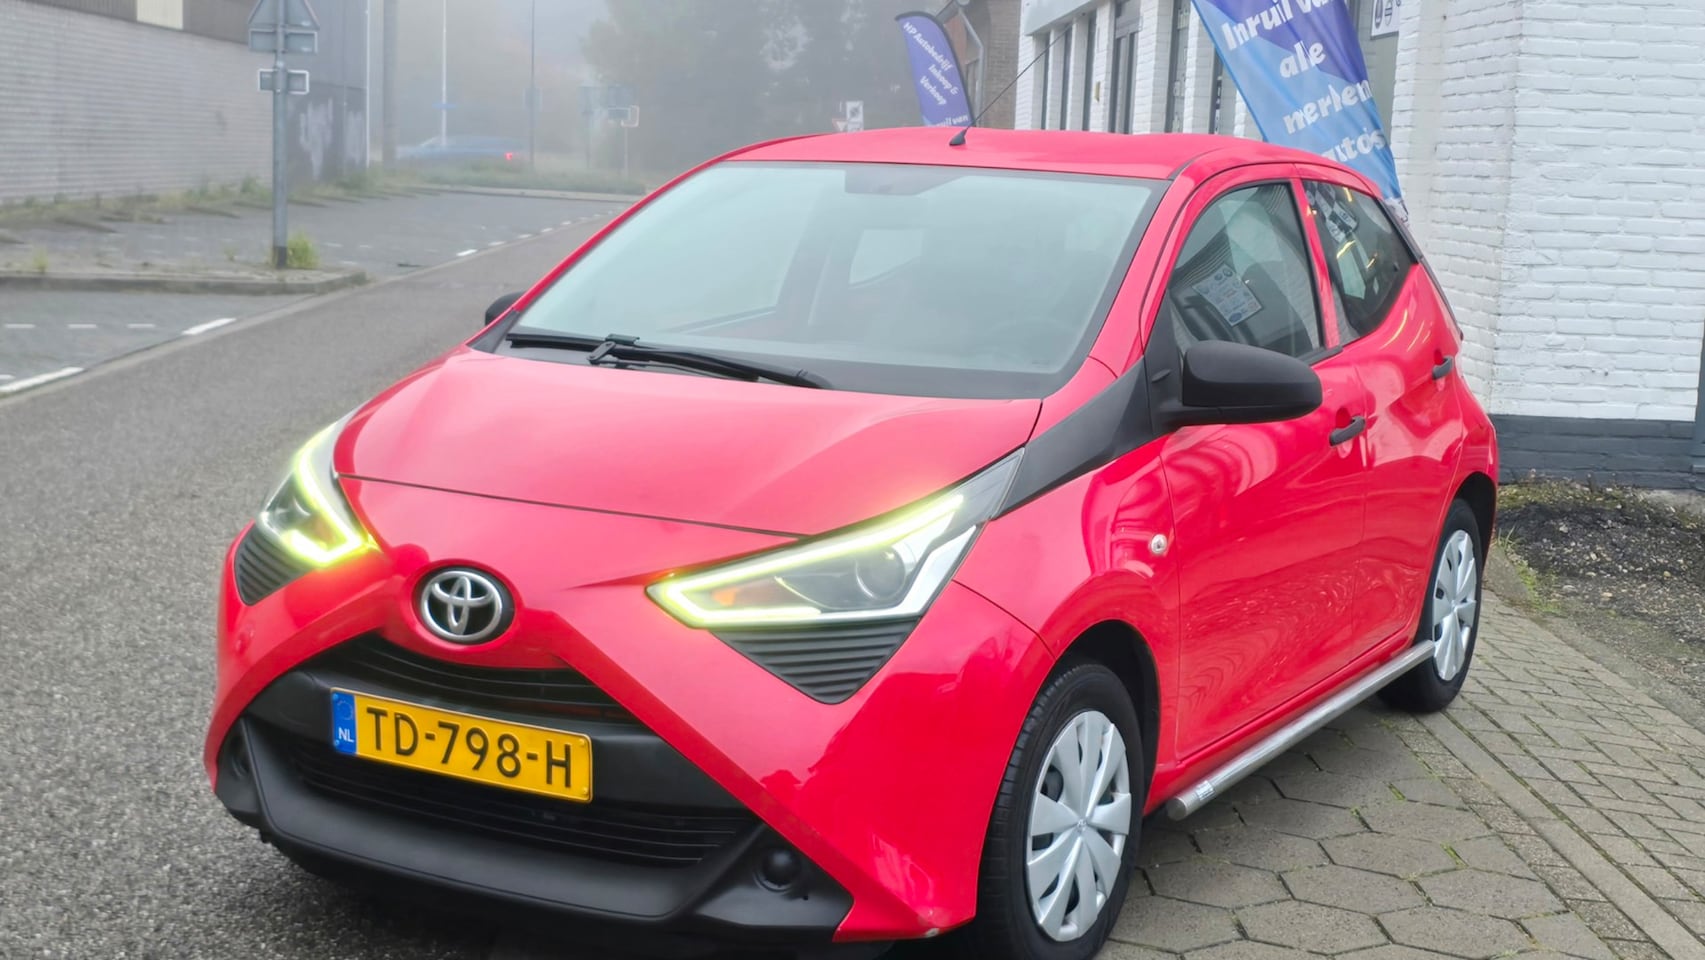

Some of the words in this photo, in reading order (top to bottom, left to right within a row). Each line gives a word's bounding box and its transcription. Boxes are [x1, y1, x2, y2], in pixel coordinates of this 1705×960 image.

[903, 21, 917, 34] HP
[913, 32, 953, 71] Autobedrijf
[1221, 0, 1293, 51] Inruil
[920, 75, 947, 105] Verkoop
[338, 727, 354, 742] NL
[366, 706, 571, 788] TD-798-H
